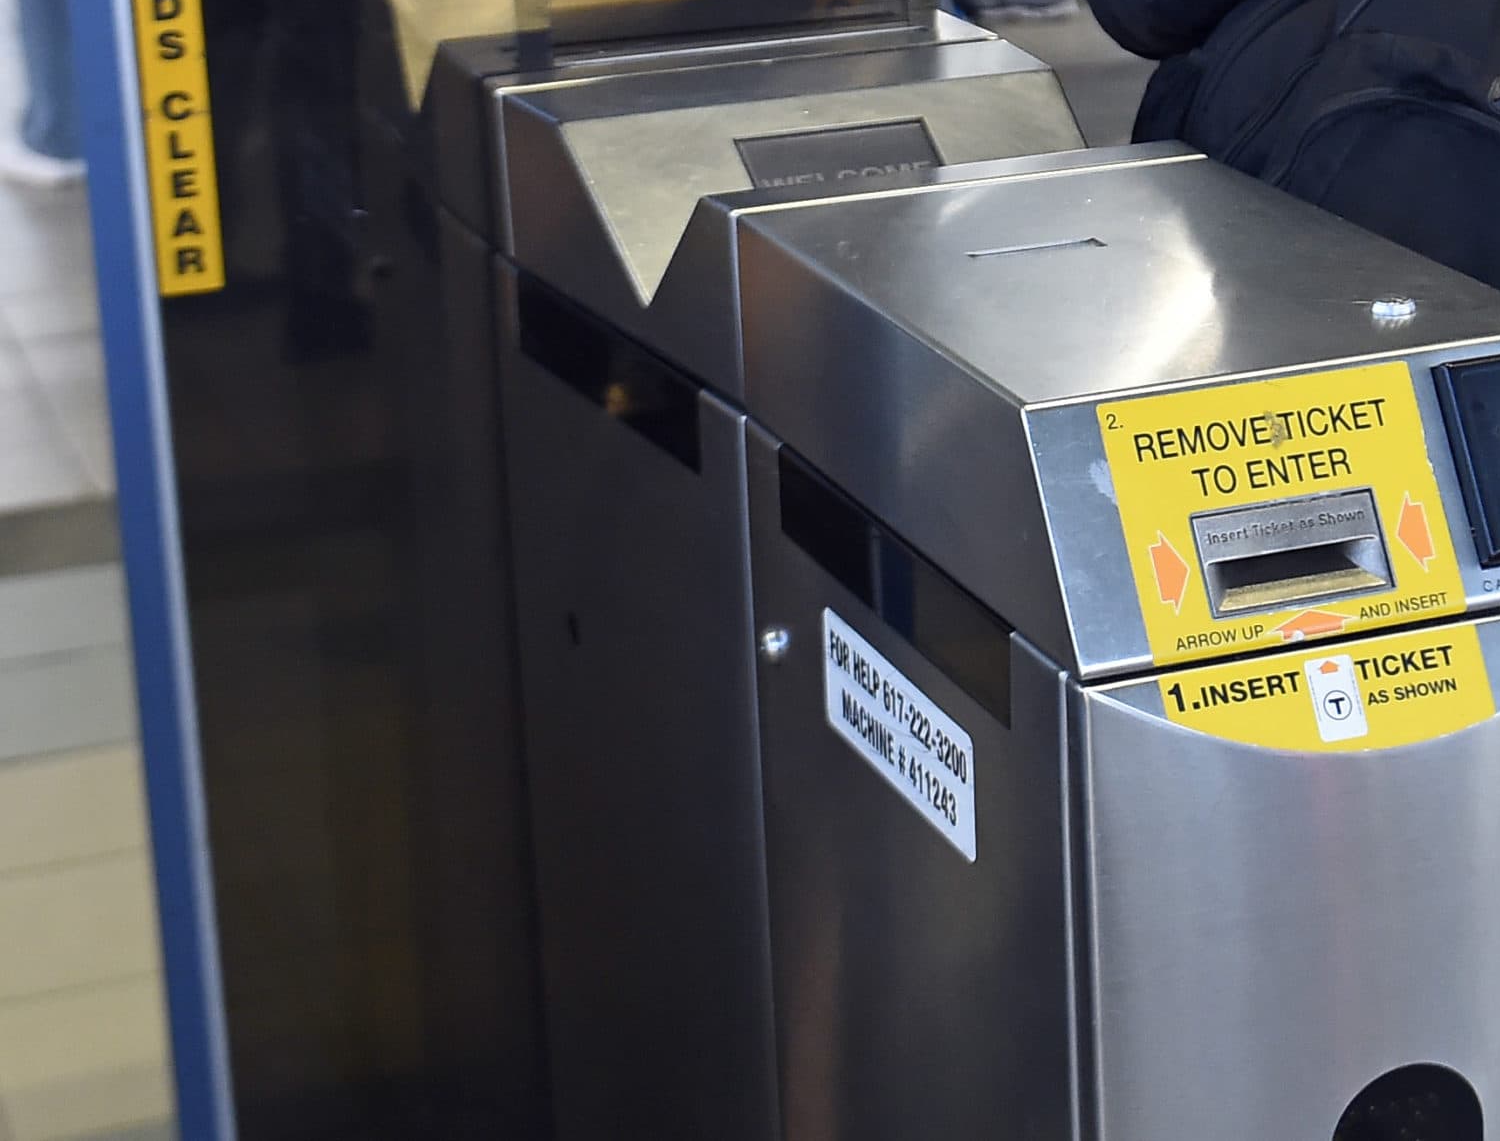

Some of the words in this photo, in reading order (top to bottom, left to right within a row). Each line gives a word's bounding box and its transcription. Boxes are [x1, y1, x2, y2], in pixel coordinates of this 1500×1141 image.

[162, 90, 205, 275] CLEAR
[1106, 414, 1124, 430] 2.
[1134, 416, 1272, 462] REMOVE
[1276, 399, 1385, 440] TICKET
[1192, 465, 1237, 496] TO
[1246, 448, 1352, 489] ENTER
[1207, 527, 1249, 545] Insert
[1252, 520, 1294, 537] Ticket
[1300, 519, 1315, 529] as
[1319, 509, 1366, 526] Shown
[1359, 603, 1392, 620] AND
[1395, 592, 1447, 616] INSERT
[1176, 629, 1238, 651] ARROW
[1241, 625, 1265, 641] UP
[1354, 645, 1453, 680] TICKET
[830, 629, 850, 674] FOR
[853, 649, 881, 699] HELP
[883, 679, 967, 784] 617-222-3200
[1368, 689, 1390, 706] AS
[1394, 679, 1458, 700] SHOWN
[842, 687, 895, 766] MACHINE
[898, 746, 906, 777] #
[909, 756, 957, 826] 411243
